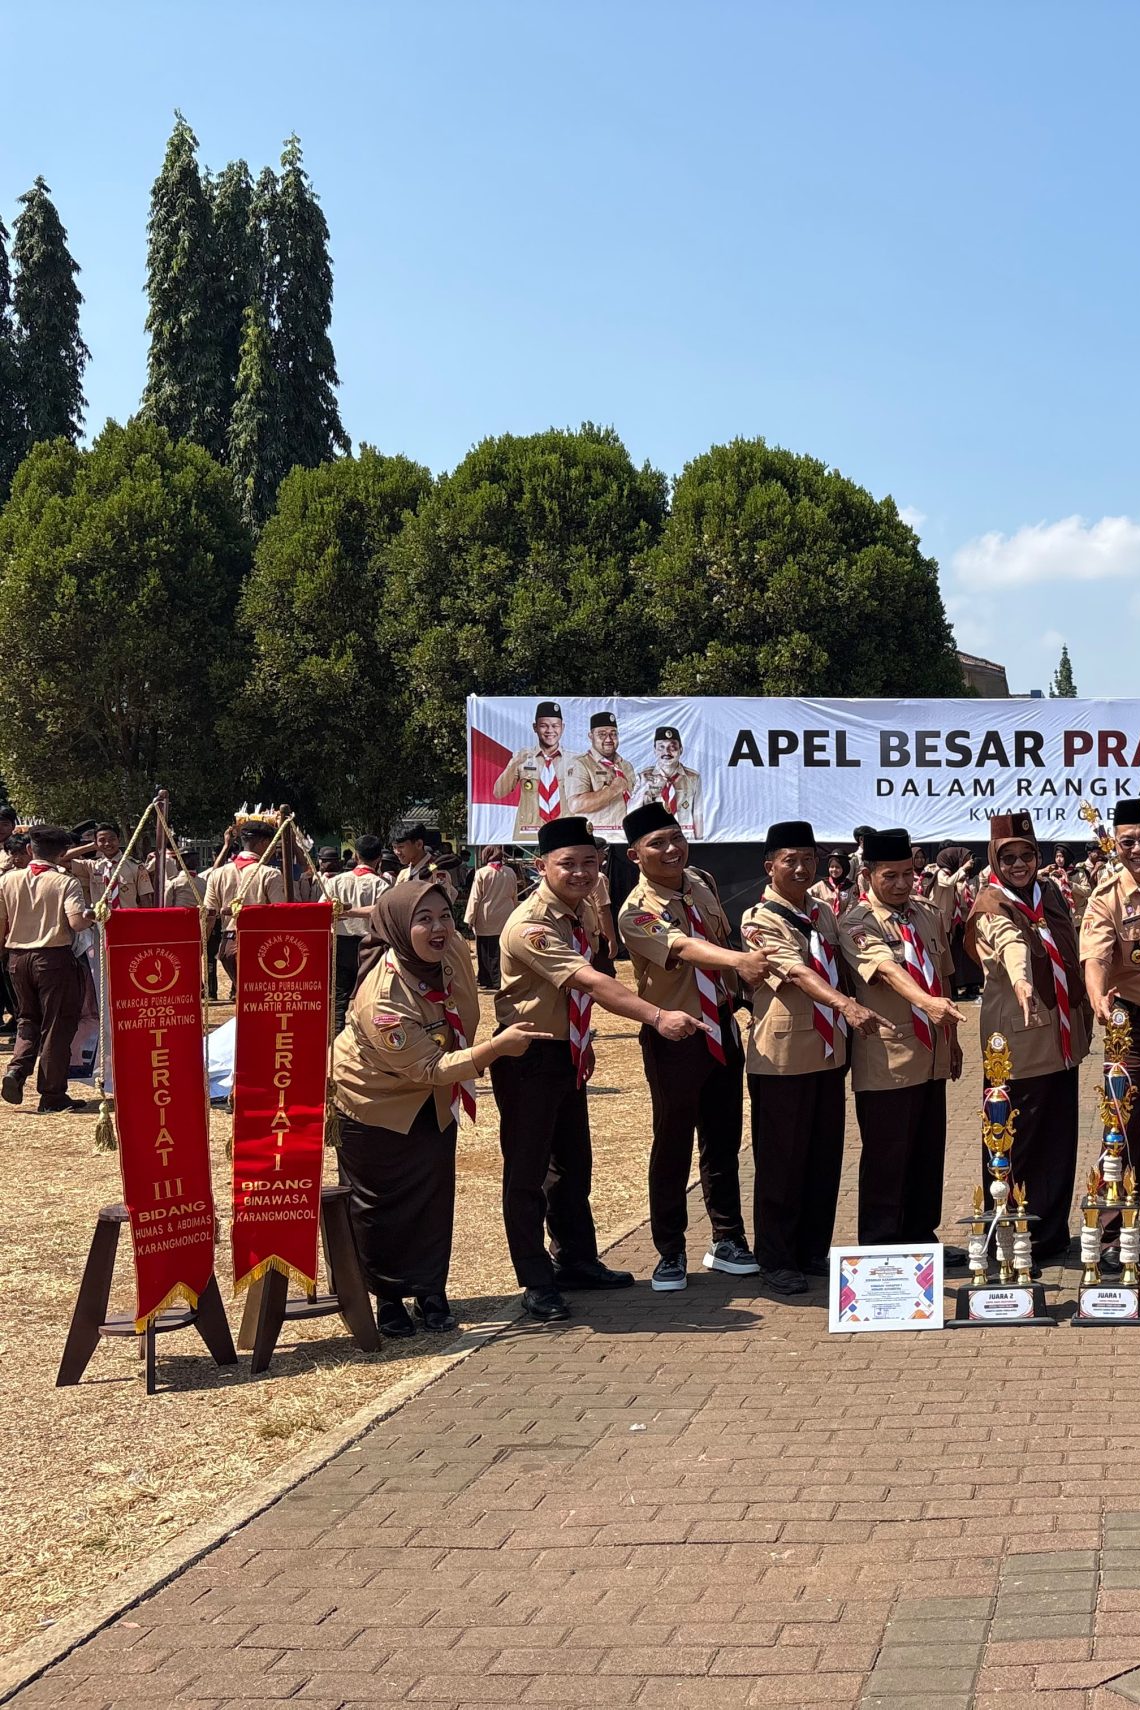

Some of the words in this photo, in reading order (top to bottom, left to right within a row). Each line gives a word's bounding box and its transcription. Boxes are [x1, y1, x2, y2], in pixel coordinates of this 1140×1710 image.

[728, 729, 862, 768] APEL
[879, 729, 1047, 768] BESAR
[876, 777, 996, 797] DALAM
[257, 934, 283, 958] GERAKAN
[285, 934, 310, 957] PRAMUKA
[129, 948, 154, 972] GERAKAN
[243, 982, 276, 992] KWARCAB
[278, 981, 323, 991] PURBALINGGA
[264, 991, 302, 1001] 2026
[115, 997, 149, 1010] KWARCAB
[150, 994, 194, 1006] PURBALINGGA
[243, 1001, 282, 1013] KWARTIR
[285, 1000, 322, 1011] RANTING
[137, 1006, 175, 1018] 2026
[117, 1016, 156, 1031] KWARTIR
[159, 1014, 196, 1027] RANTING
[270, 1013, 294, 1147] TERGIAT
[149, 1028, 175, 1167] TERGIAT
[272, 1153, 284, 1172] I
[152, 1178, 185, 1201] III
[241, 1178, 313, 1192] BIDANG
[243, 1194, 309, 1207] BINAWASA
[138, 1200, 207, 1223] BIDANG
[235, 1209, 317, 1223] KARANGMONCOL
[135, 1224, 164, 1240] HUMAS
[167, 1222, 174, 1233] &
[177, 1215, 212, 1231] ABDIMAS
[137, 1231, 212, 1257] KARANGMONCOL
